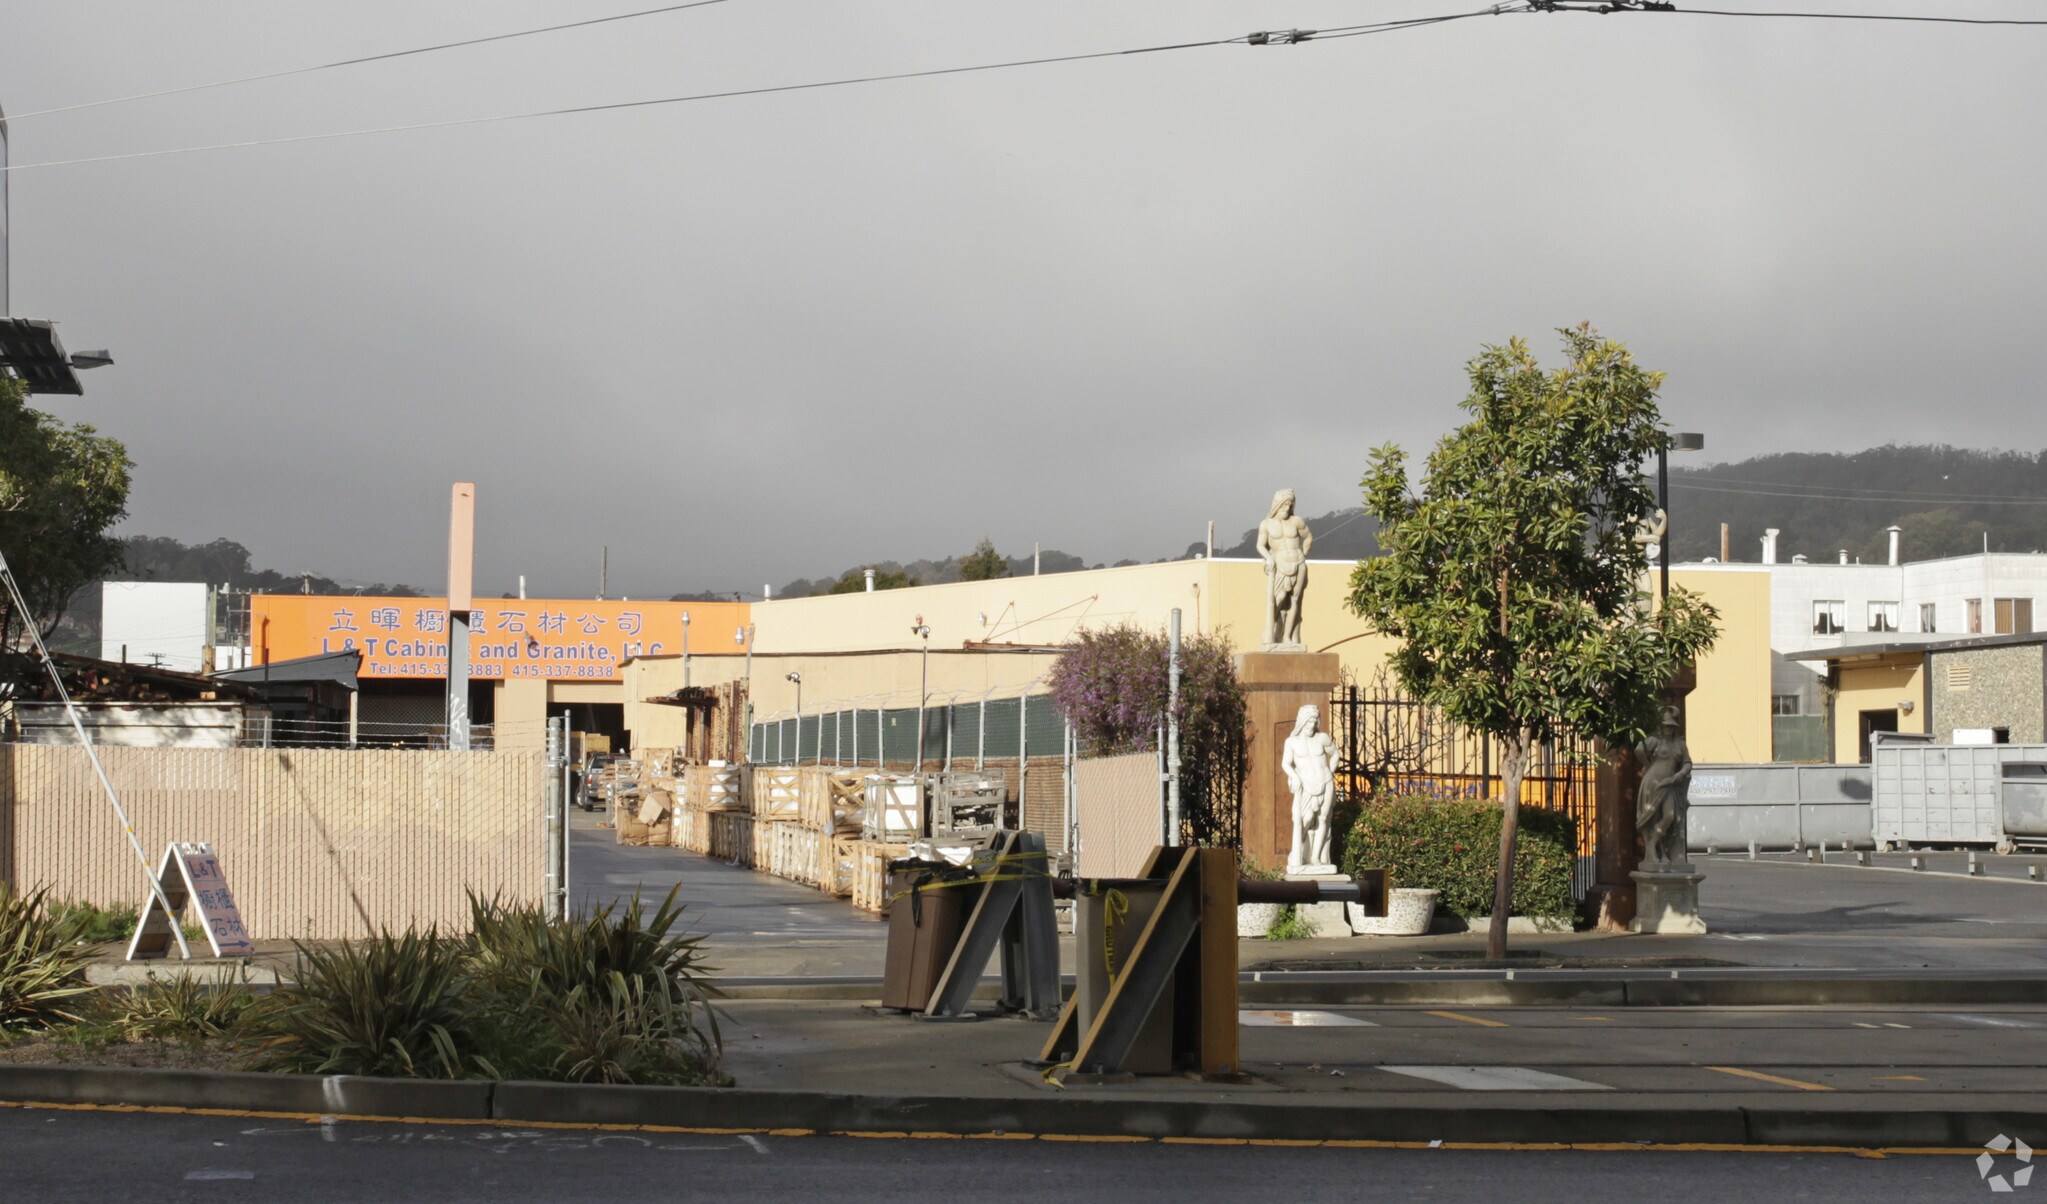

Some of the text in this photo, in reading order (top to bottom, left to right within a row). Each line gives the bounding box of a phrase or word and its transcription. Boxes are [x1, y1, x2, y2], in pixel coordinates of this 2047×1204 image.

[365, 638, 378, 656] T
[385, 639, 471, 658] Cabin
[480, 641, 518, 659] and
[527, 641, 616, 662] Granite,
[512, 665, 613, 677] 415-337-8838
[188, 860, 218, 879] L&T
[210, 916, 245, 936] 石材
